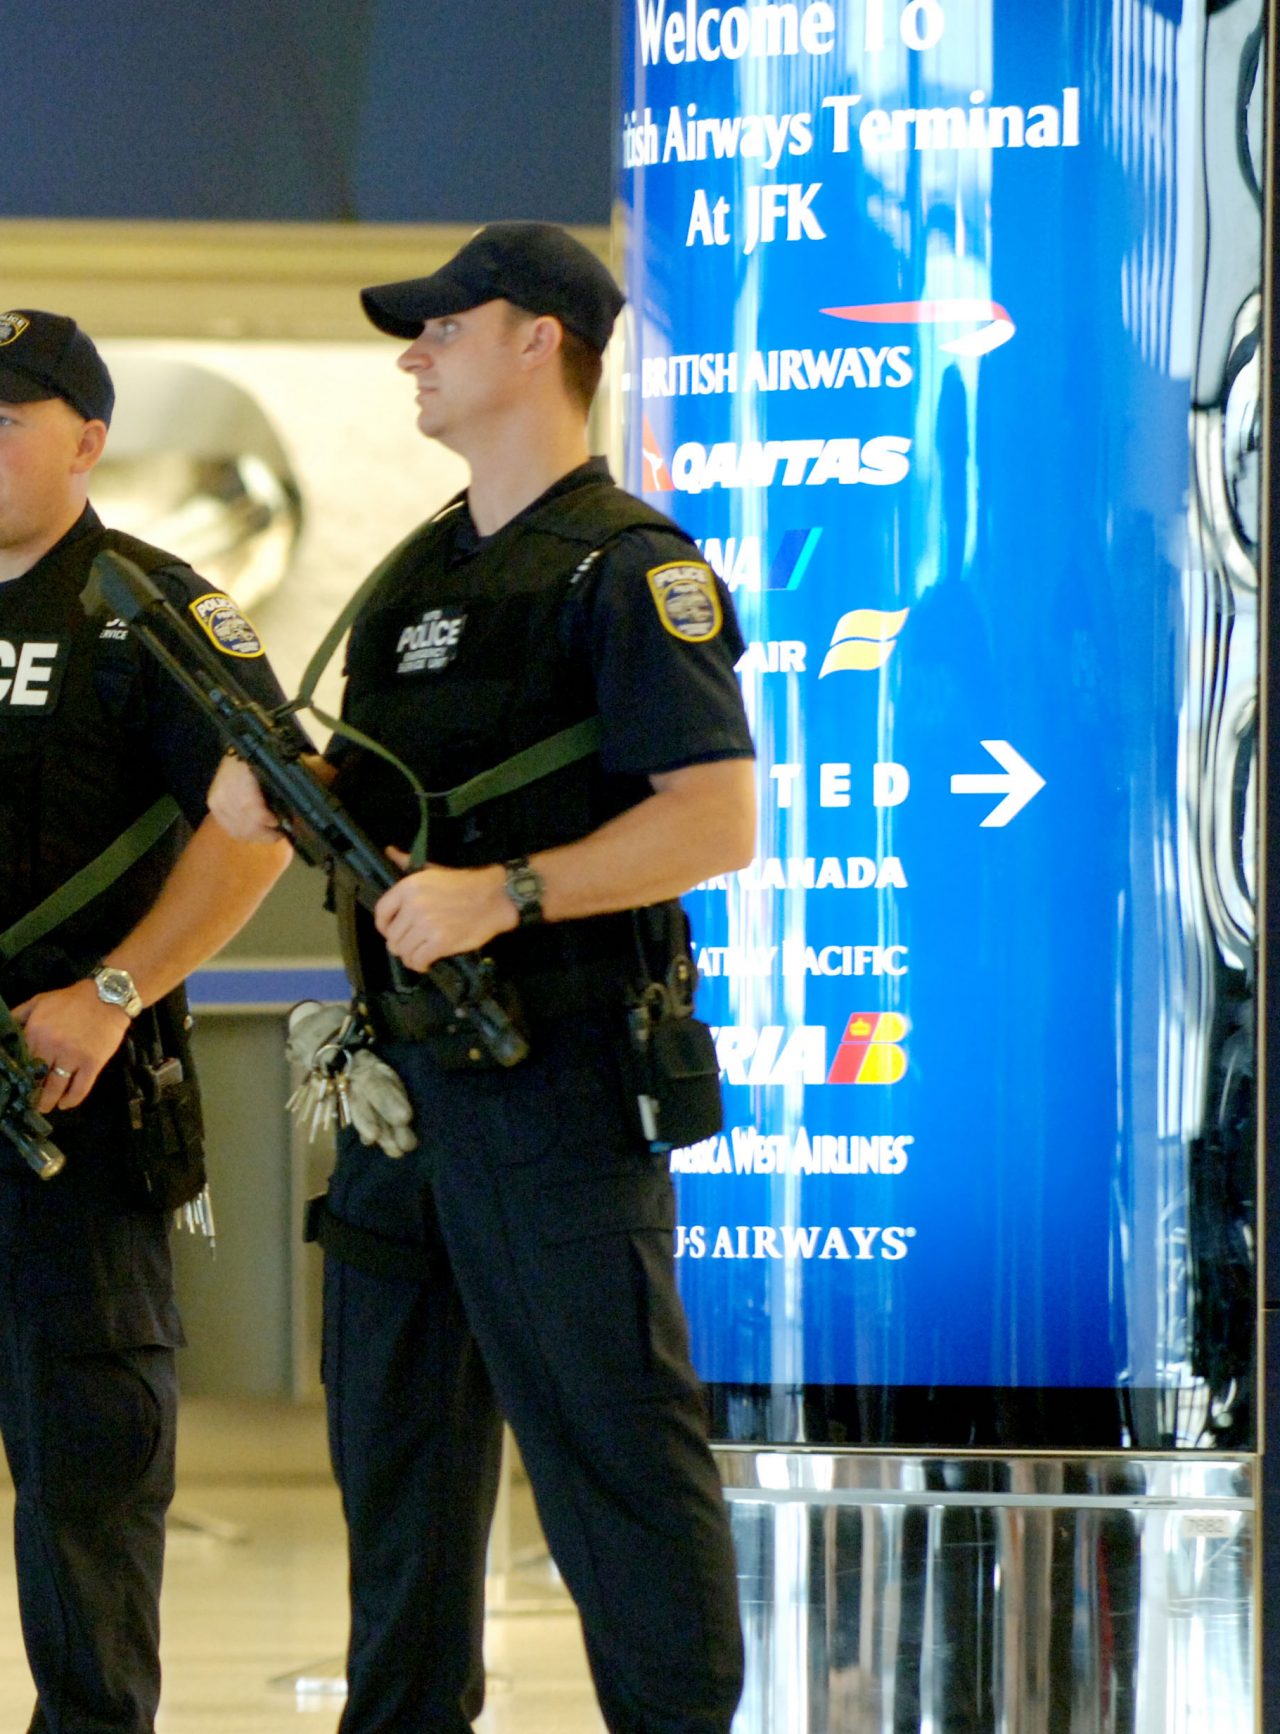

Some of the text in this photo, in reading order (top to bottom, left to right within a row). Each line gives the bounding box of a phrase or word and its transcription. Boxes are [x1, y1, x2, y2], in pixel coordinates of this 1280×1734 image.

[638, 0, 835, 67] Welcome
[663, 103, 813, 170] Airways
[822, 87, 1080, 153] Terminal
[686, 183, 827, 256] At JFK
[642, 346, 913, 398] BRITISH AIRWAYS
[671, 436, 912, 493] QANTAS
[396, 618, 463, 653] POLICE
